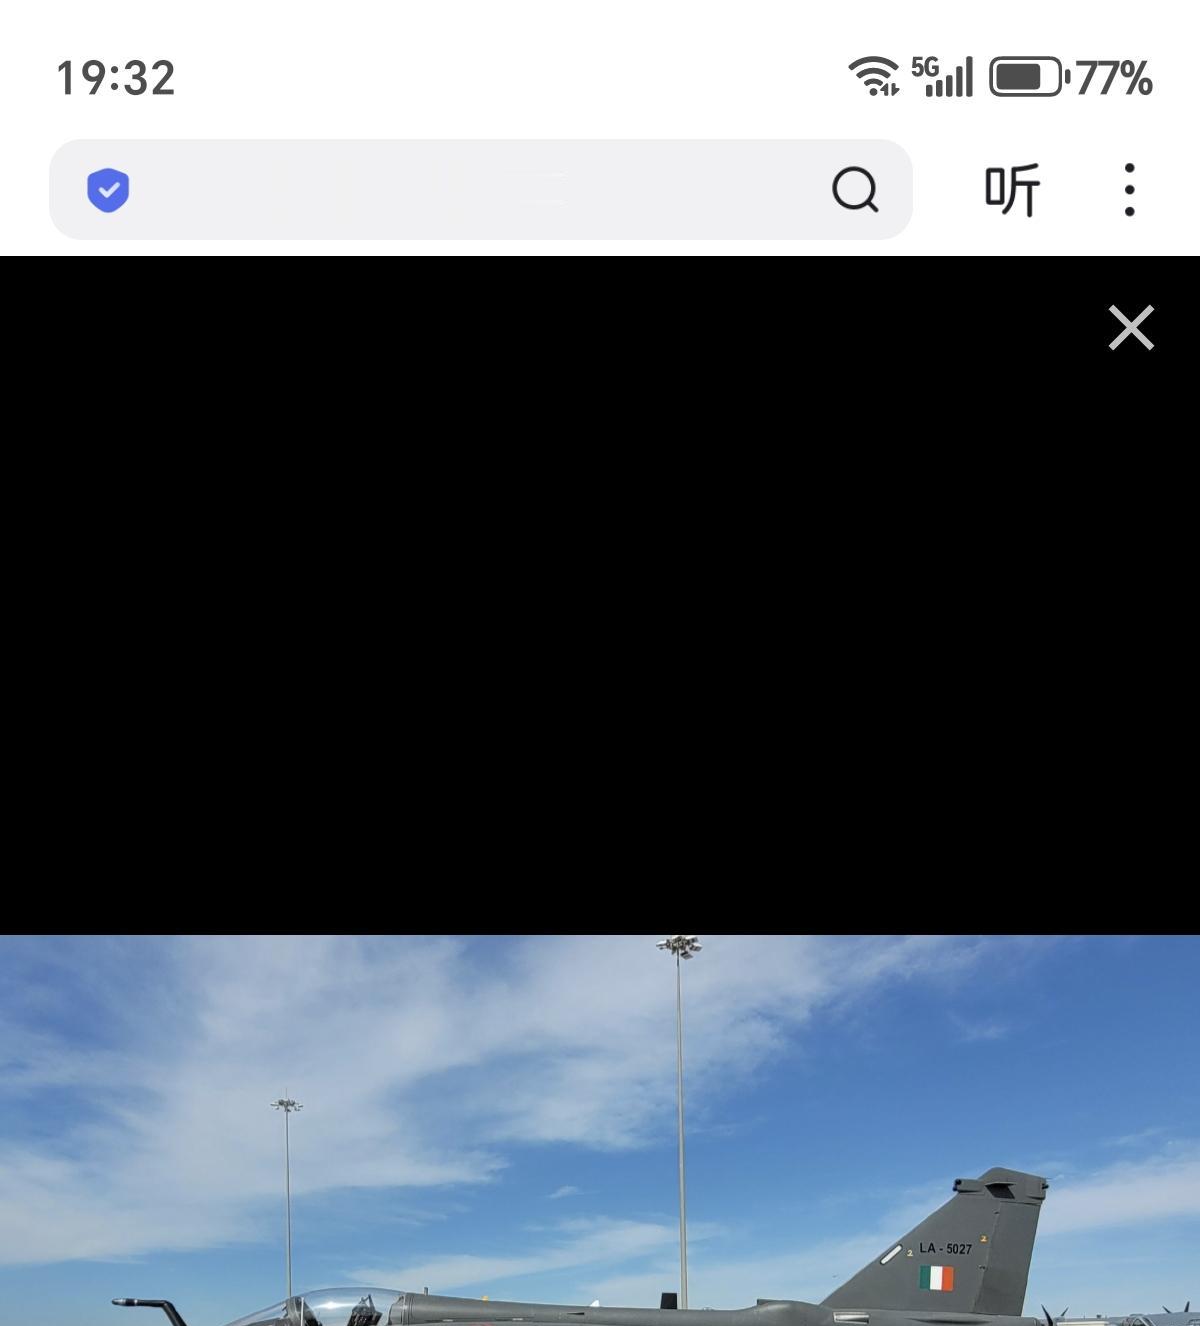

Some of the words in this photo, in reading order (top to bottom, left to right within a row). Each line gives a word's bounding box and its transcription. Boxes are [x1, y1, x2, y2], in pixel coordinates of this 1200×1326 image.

[57, 58, 176, 97] 19:32
[910, 55, 941, 78] 5G
[1074, 58, 1155, 96] 77%
[985, 162, 1042, 219] 听
[919, 1242, 936, 1254] LA
[946, 1243, 973, 1256] 5027
